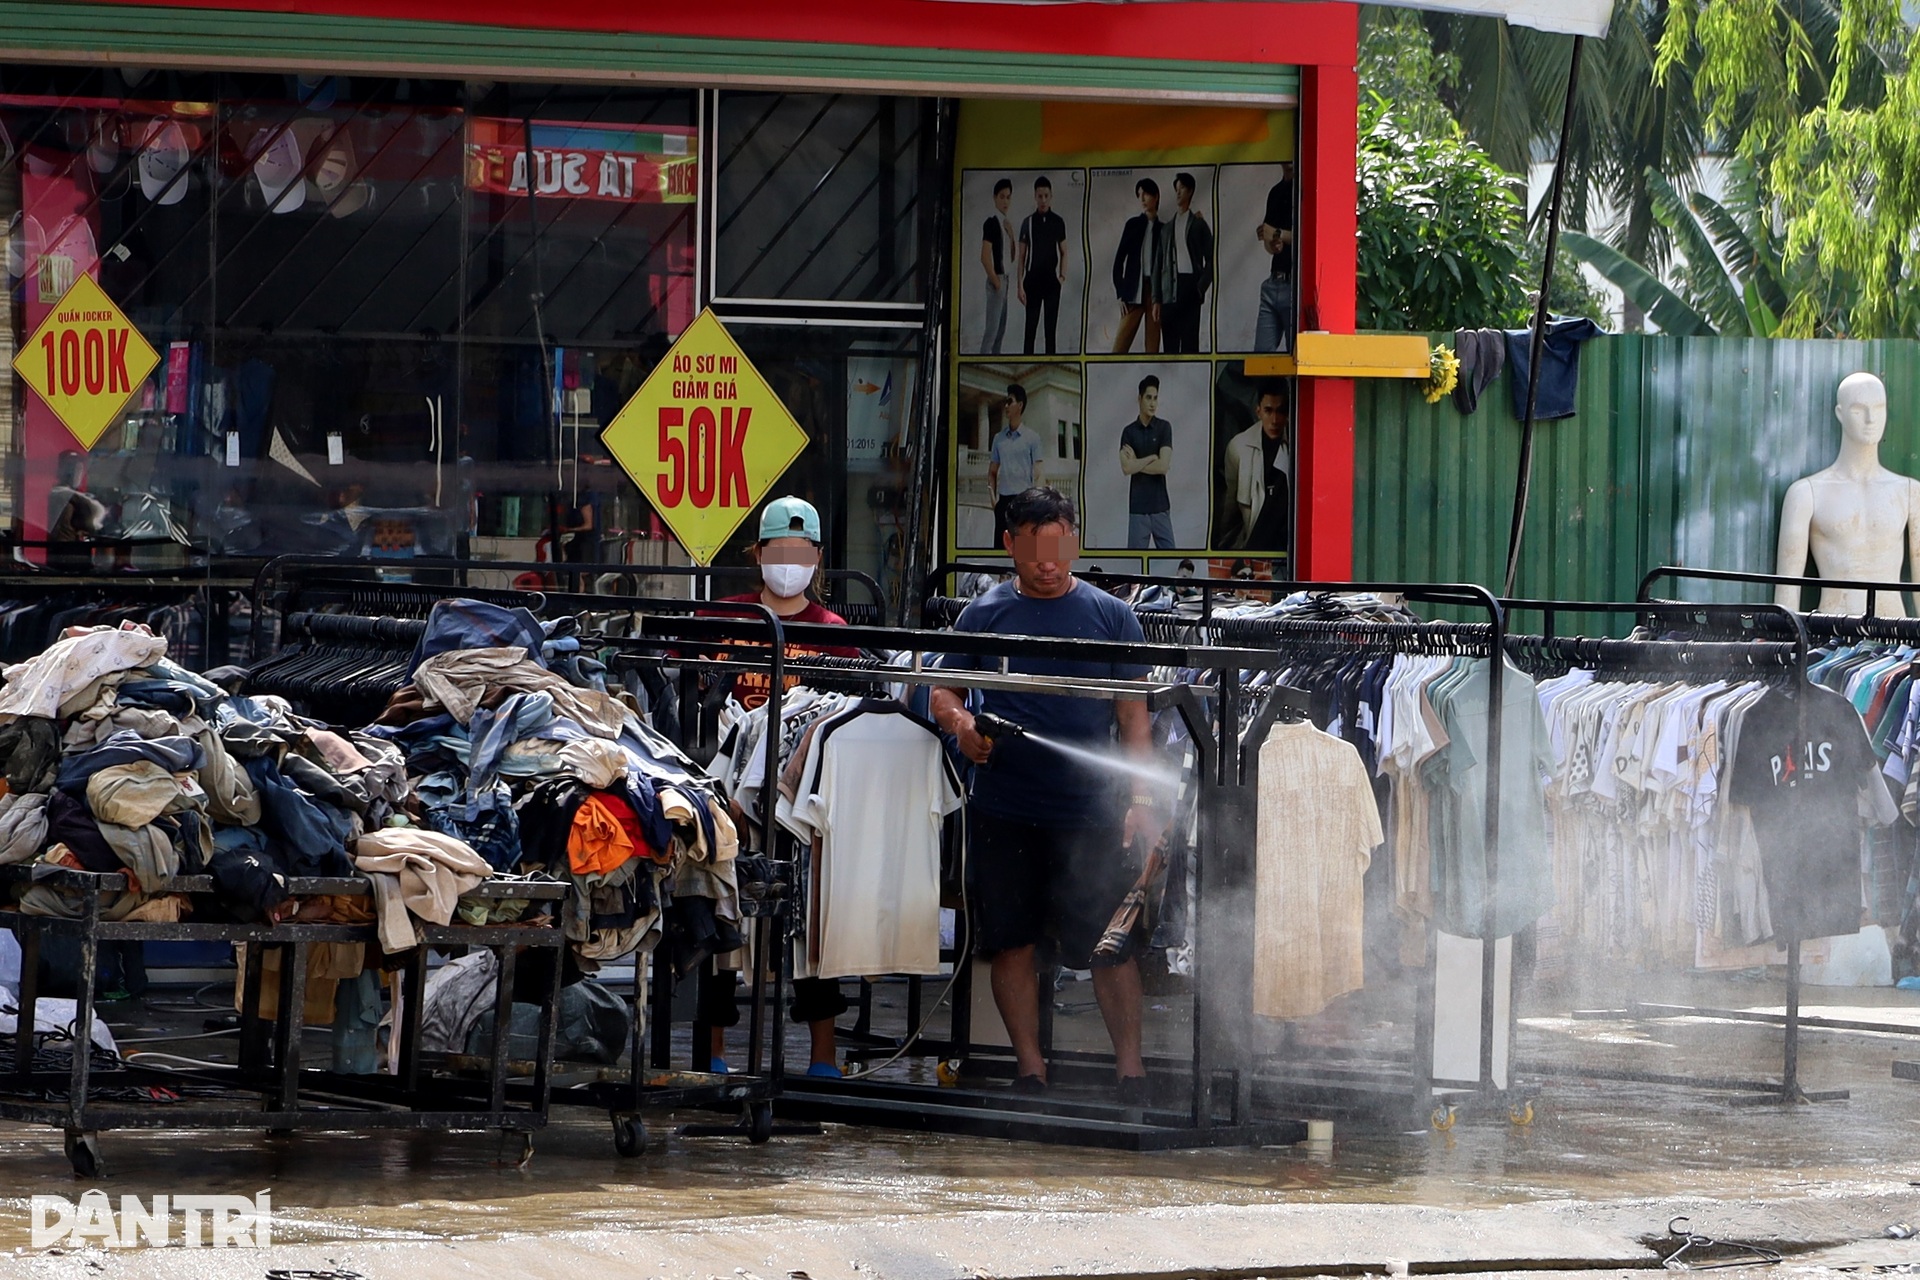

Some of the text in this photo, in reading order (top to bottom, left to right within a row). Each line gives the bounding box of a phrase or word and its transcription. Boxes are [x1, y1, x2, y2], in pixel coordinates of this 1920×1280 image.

[82, 310, 113, 322] JOCKER
[41, 328, 131, 397] 100K
[673, 350, 738, 375] ÁO SƠ MI
[672, 374, 738, 400] GIẢM GIÁ
[656, 406, 753, 509] 50K
